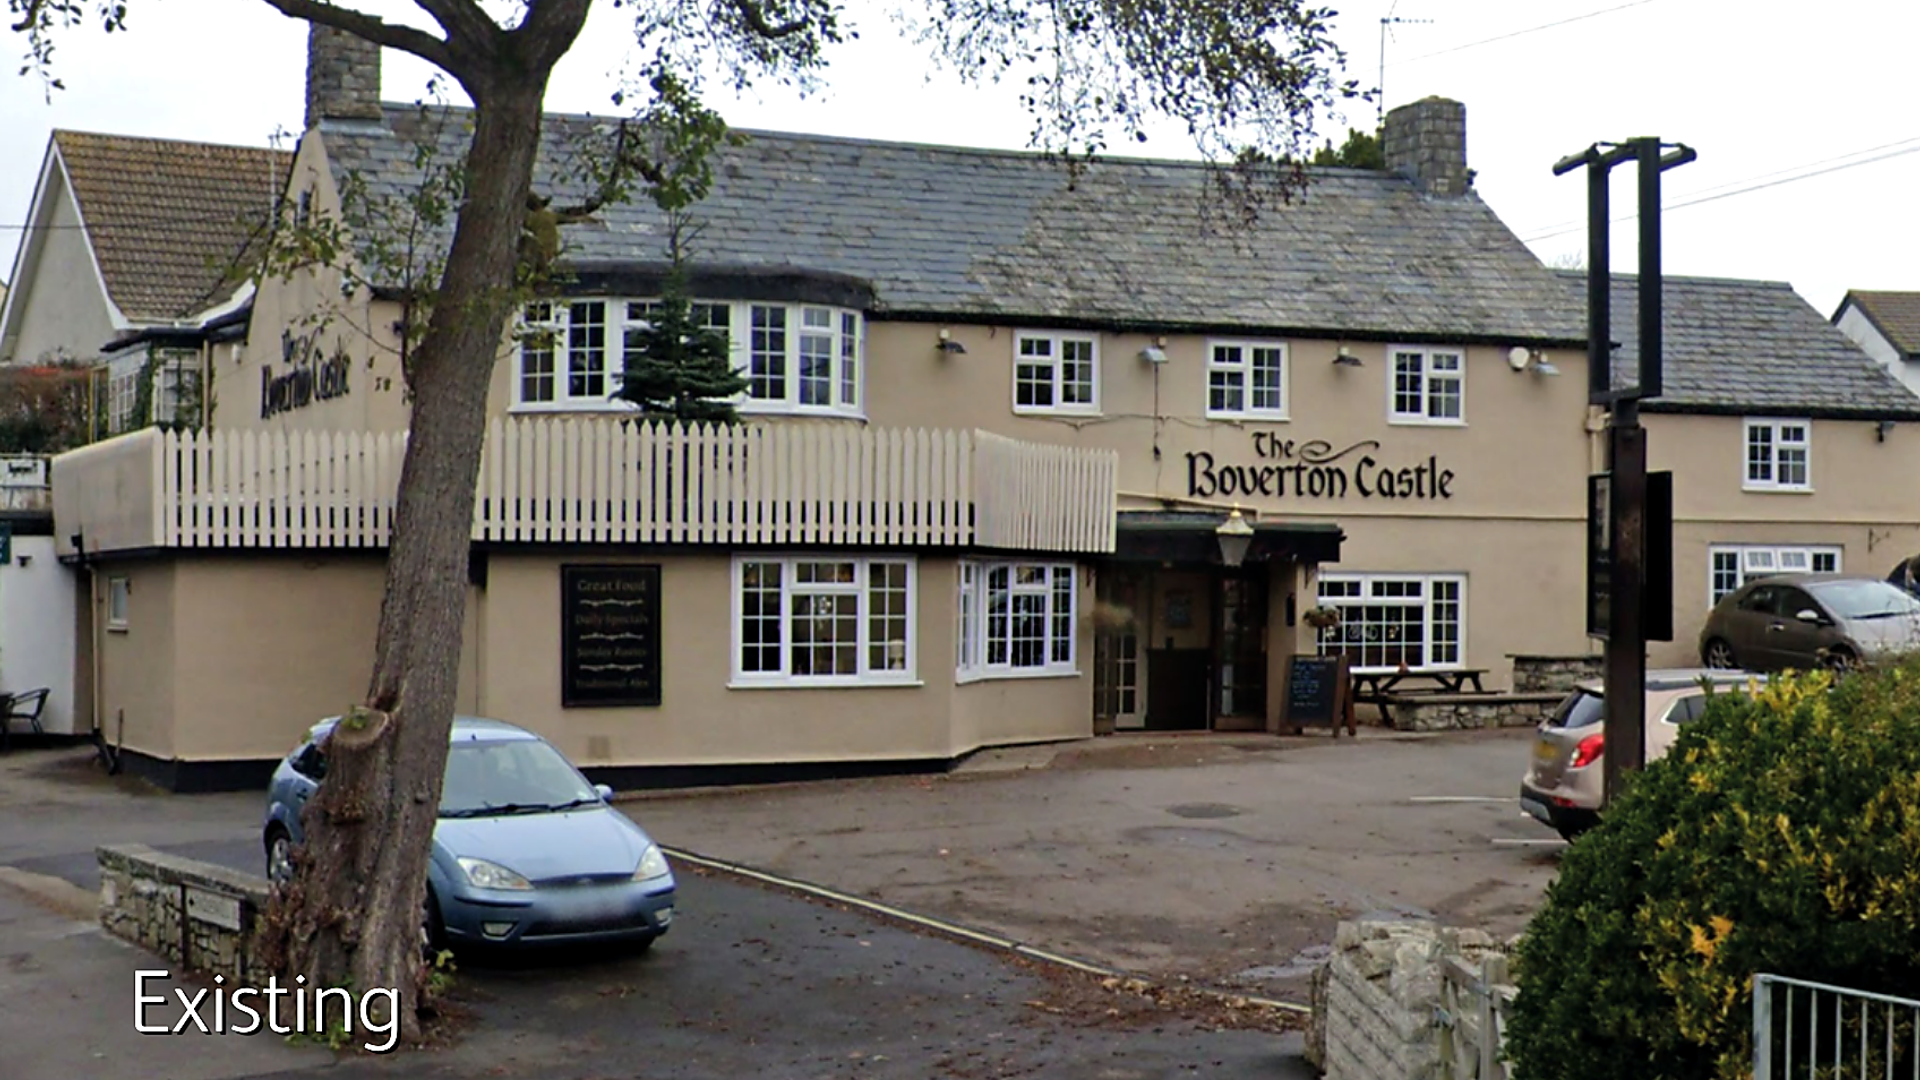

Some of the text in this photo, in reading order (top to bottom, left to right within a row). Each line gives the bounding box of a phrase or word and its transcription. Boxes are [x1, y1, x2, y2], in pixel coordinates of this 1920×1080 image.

[1252, 432, 1294, 459] The
[1185, 451, 1454, 499] Boverton Castle
[577, 579, 646, 591] Great Food
[575, 613, 648, 628] Daily Specials
